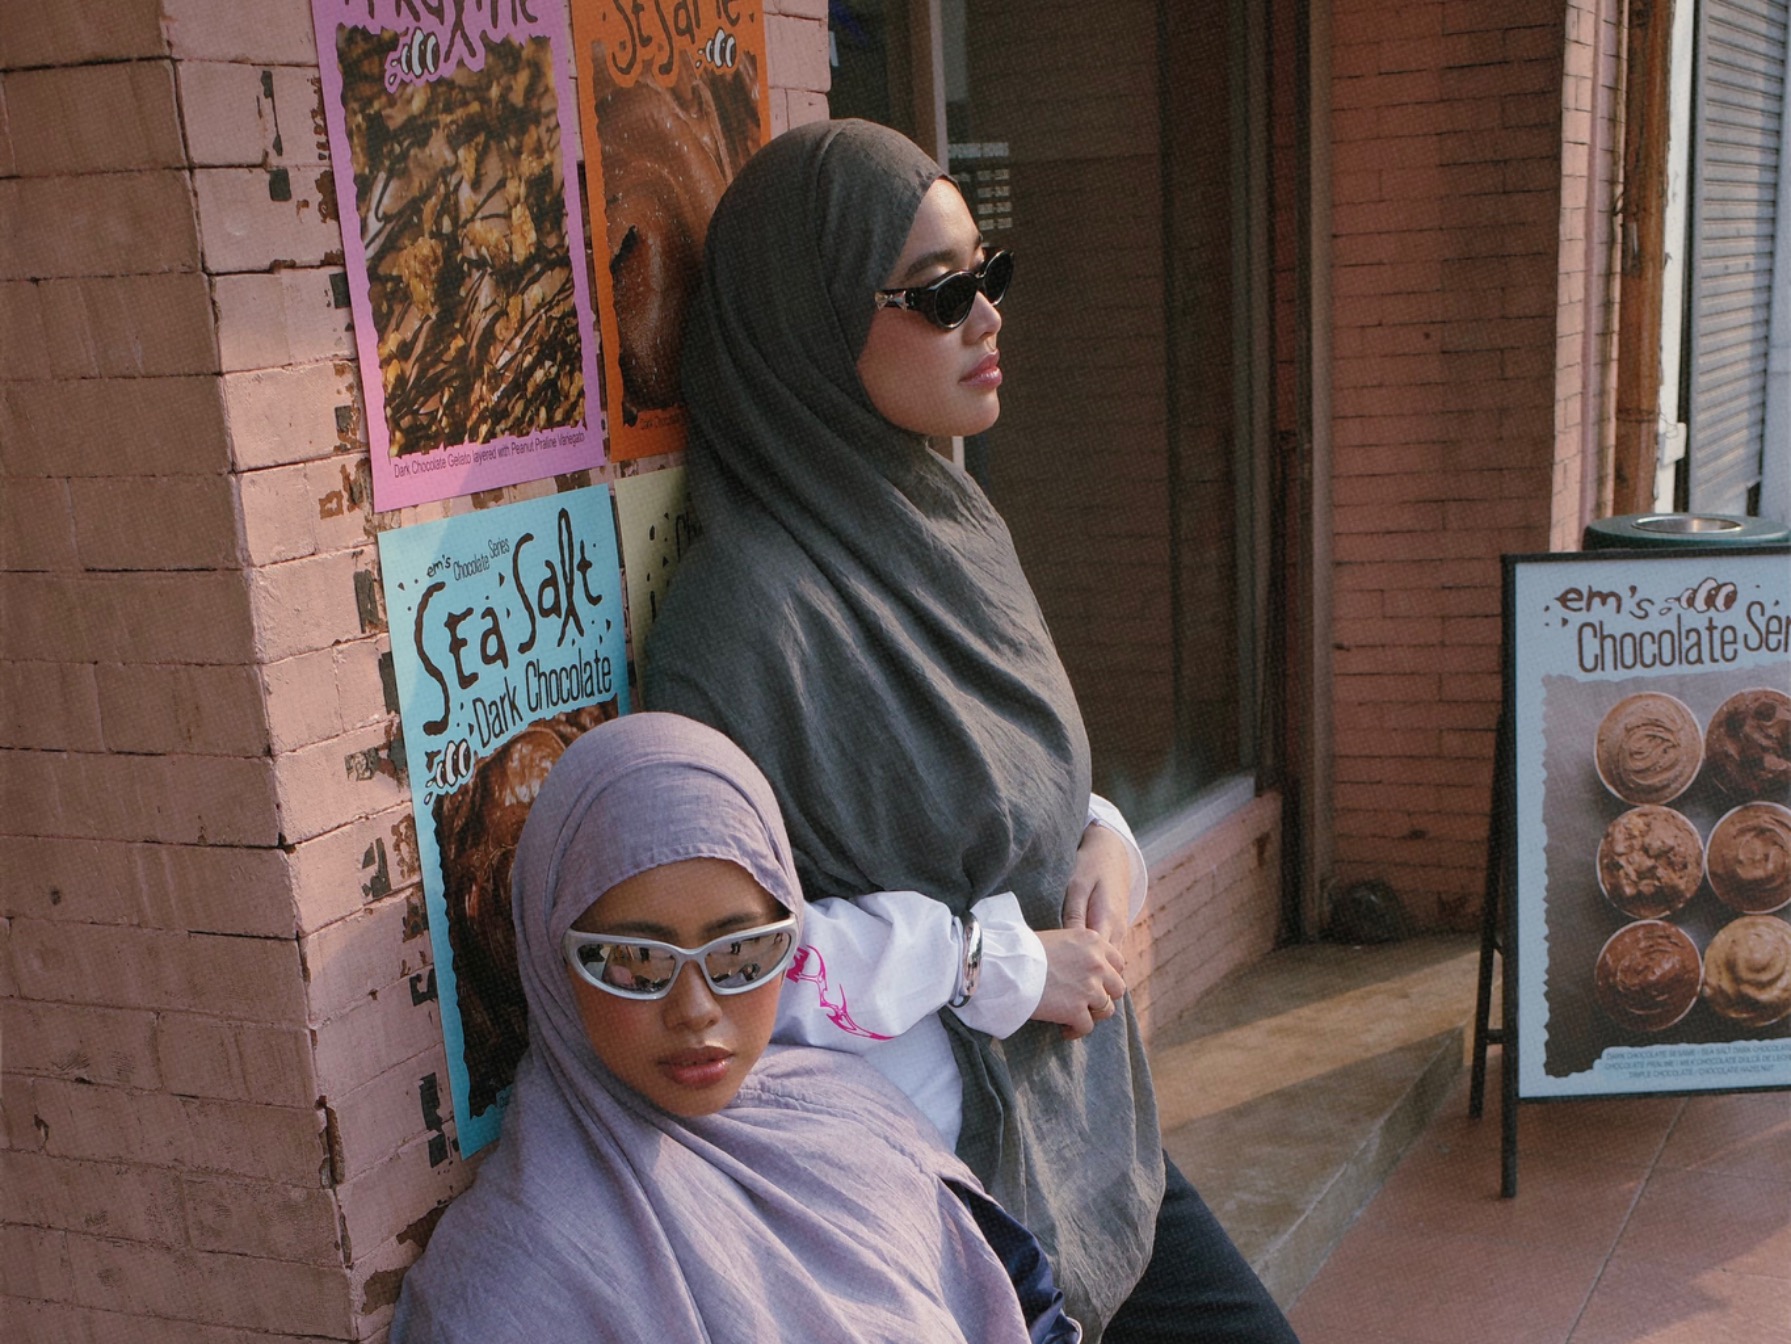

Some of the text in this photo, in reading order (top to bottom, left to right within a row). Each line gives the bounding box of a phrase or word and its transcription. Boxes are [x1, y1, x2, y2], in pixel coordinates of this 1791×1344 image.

[394, 463, 411, 478] Dark
[412, 457, 446, 474] Chocolate
[448, 452, 471, 467] Gelato
[472, 447, 497, 466] layered
[498, 444, 510, 458] with
[511, 440, 534, 455] Peanut
[535, 435, 557, 452] Praline
[426, 537, 510, 581] em's Chocolate Series
[1555, 584, 1655, 620] em's
[1578, 613, 1738, 673] Chocolate
[472, 647, 612, 748] Dark Chocolate
